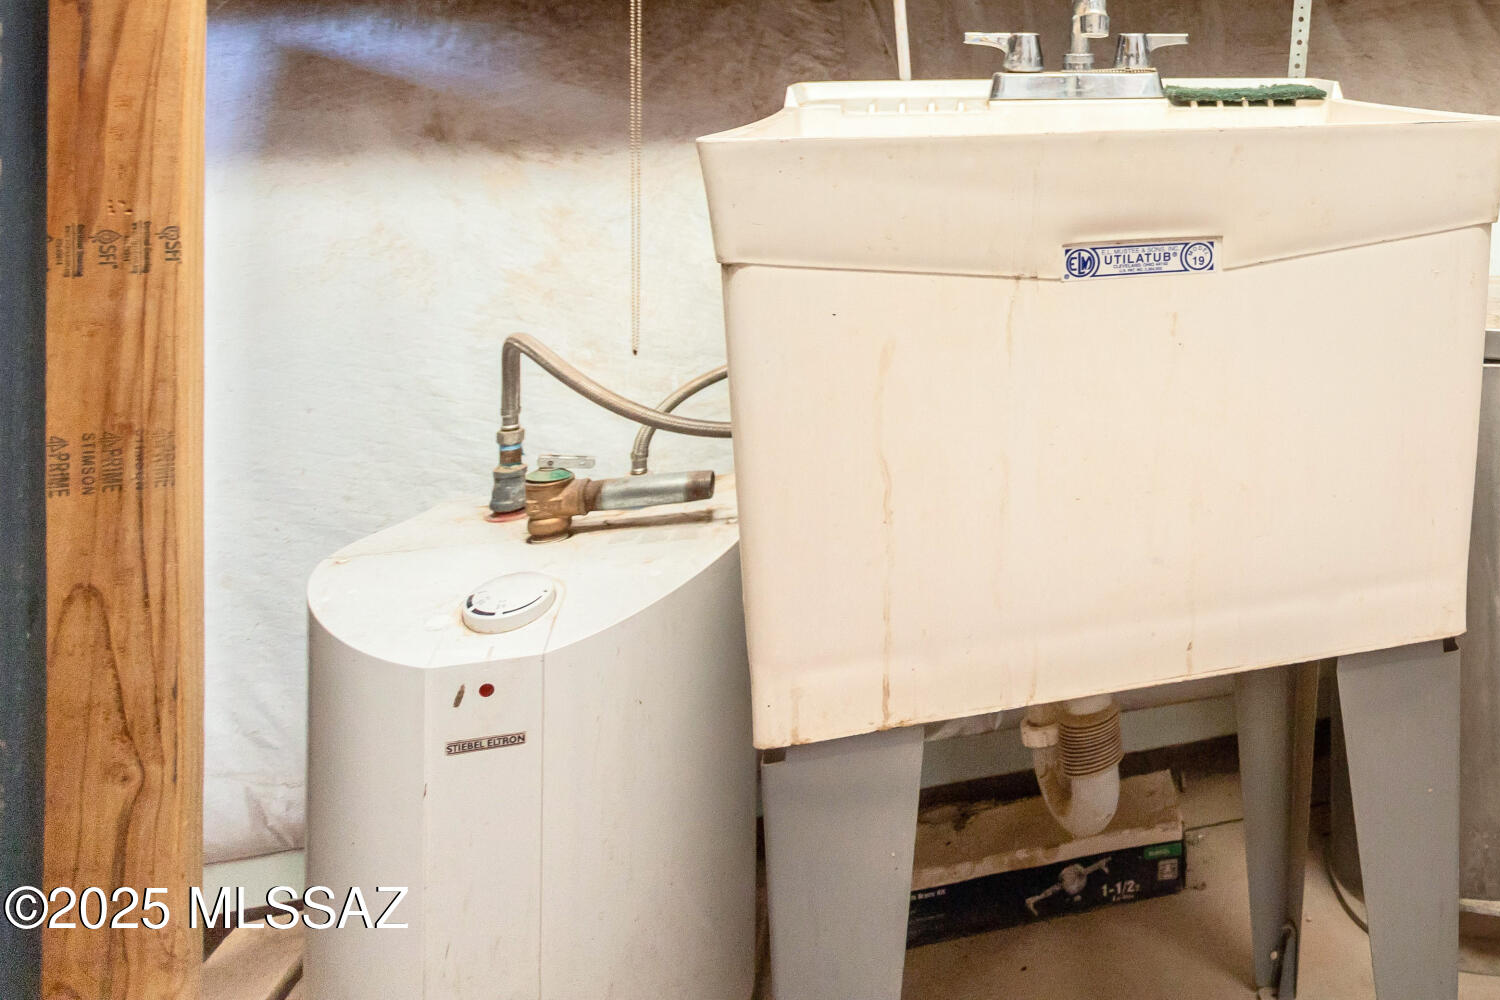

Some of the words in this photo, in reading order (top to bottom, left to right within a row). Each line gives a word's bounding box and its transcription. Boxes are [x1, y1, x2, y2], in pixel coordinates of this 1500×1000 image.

[1192, 256, 1205, 266] 19
[48, 453, 71, 499] PRIME
[81, 432, 96, 496] STIMSON
[101, 448, 124, 494] PRIME
[446, 741, 486, 753] STIEBEL
[487, 734, 526, 748] ELTRON
